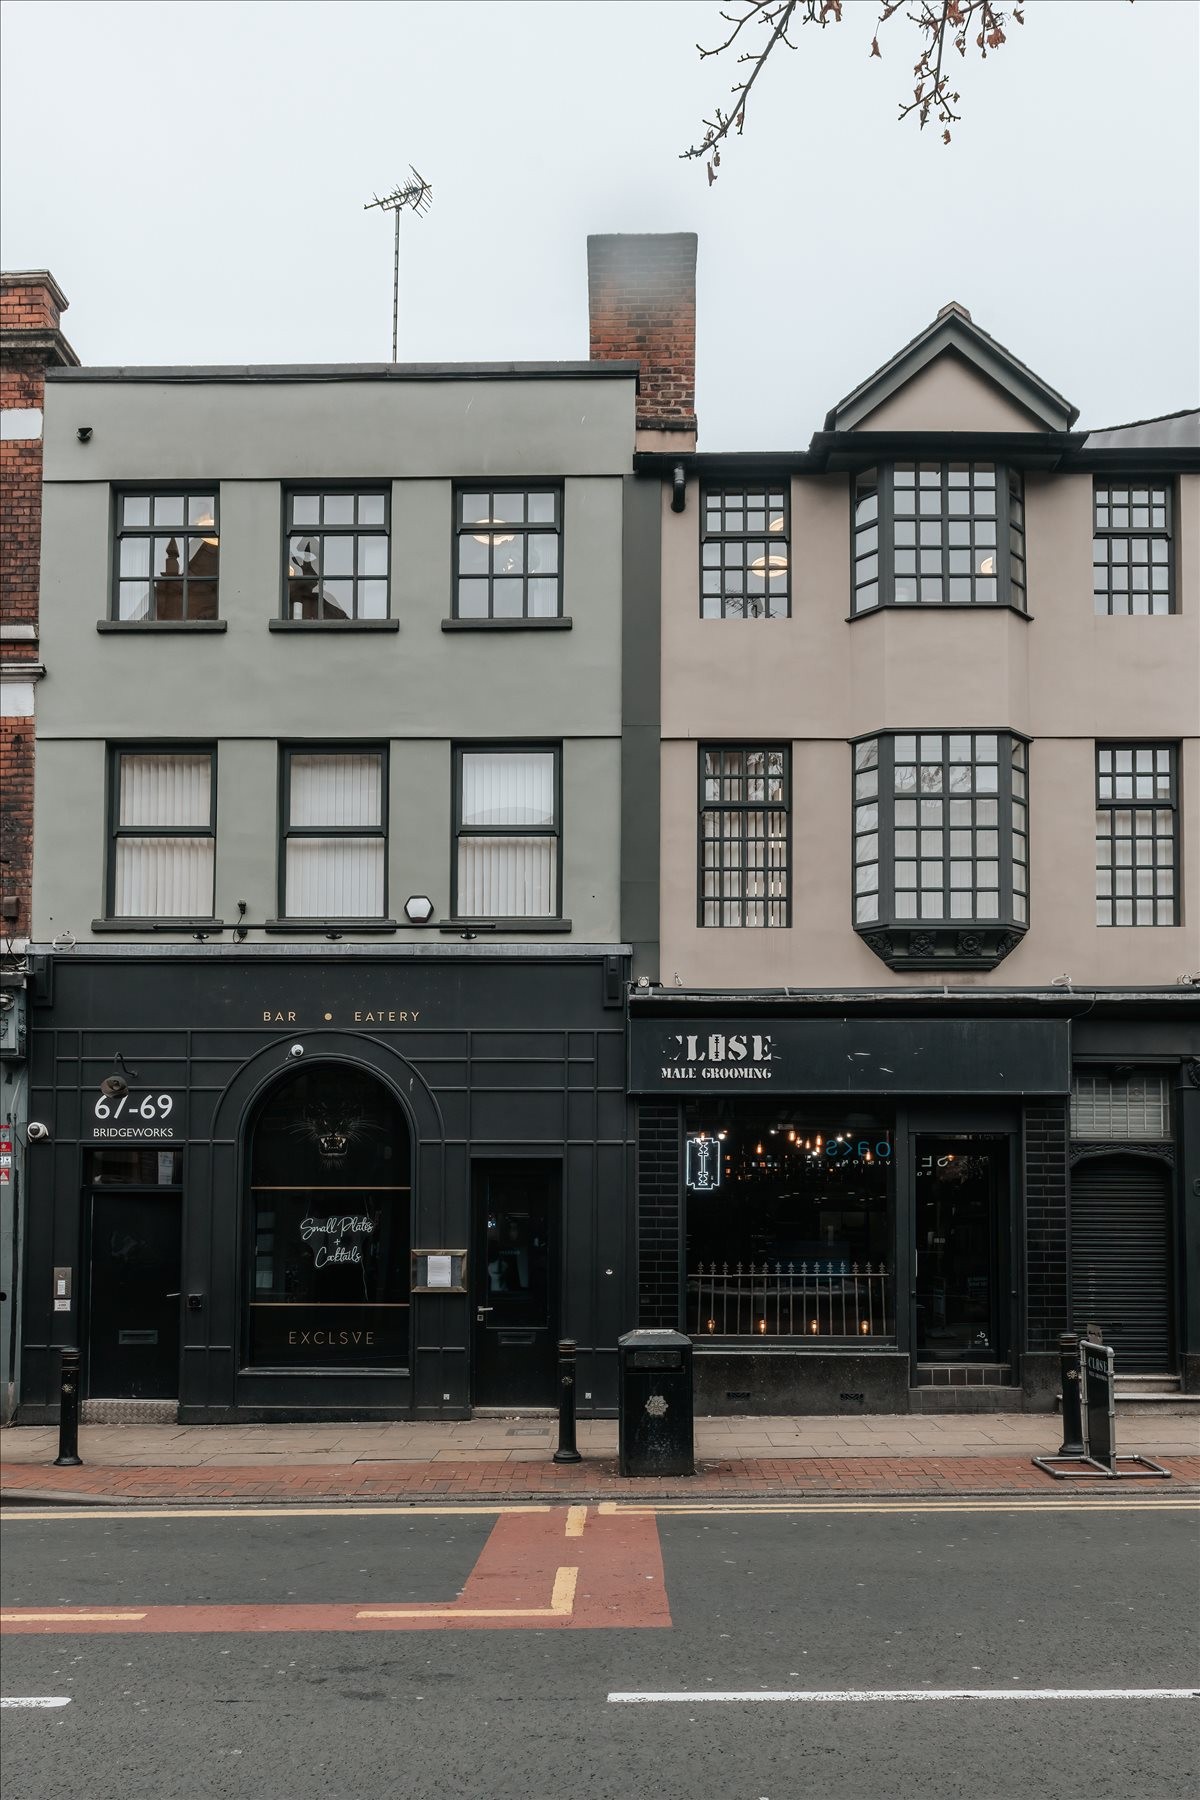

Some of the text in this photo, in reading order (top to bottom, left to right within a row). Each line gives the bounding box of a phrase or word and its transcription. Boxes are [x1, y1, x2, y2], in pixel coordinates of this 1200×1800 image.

[263, 1011, 420, 1022] BAR EATERY
[661, 1067, 772, 1079] MALE GROOMING
[94, 1094, 173, 1119] 67-69
[93, 1128, 174, 1137] BRIDGEWORKS
[300, 1216, 374, 1240] Small Plates
[315, 1246, 362, 1268] Cocktails
